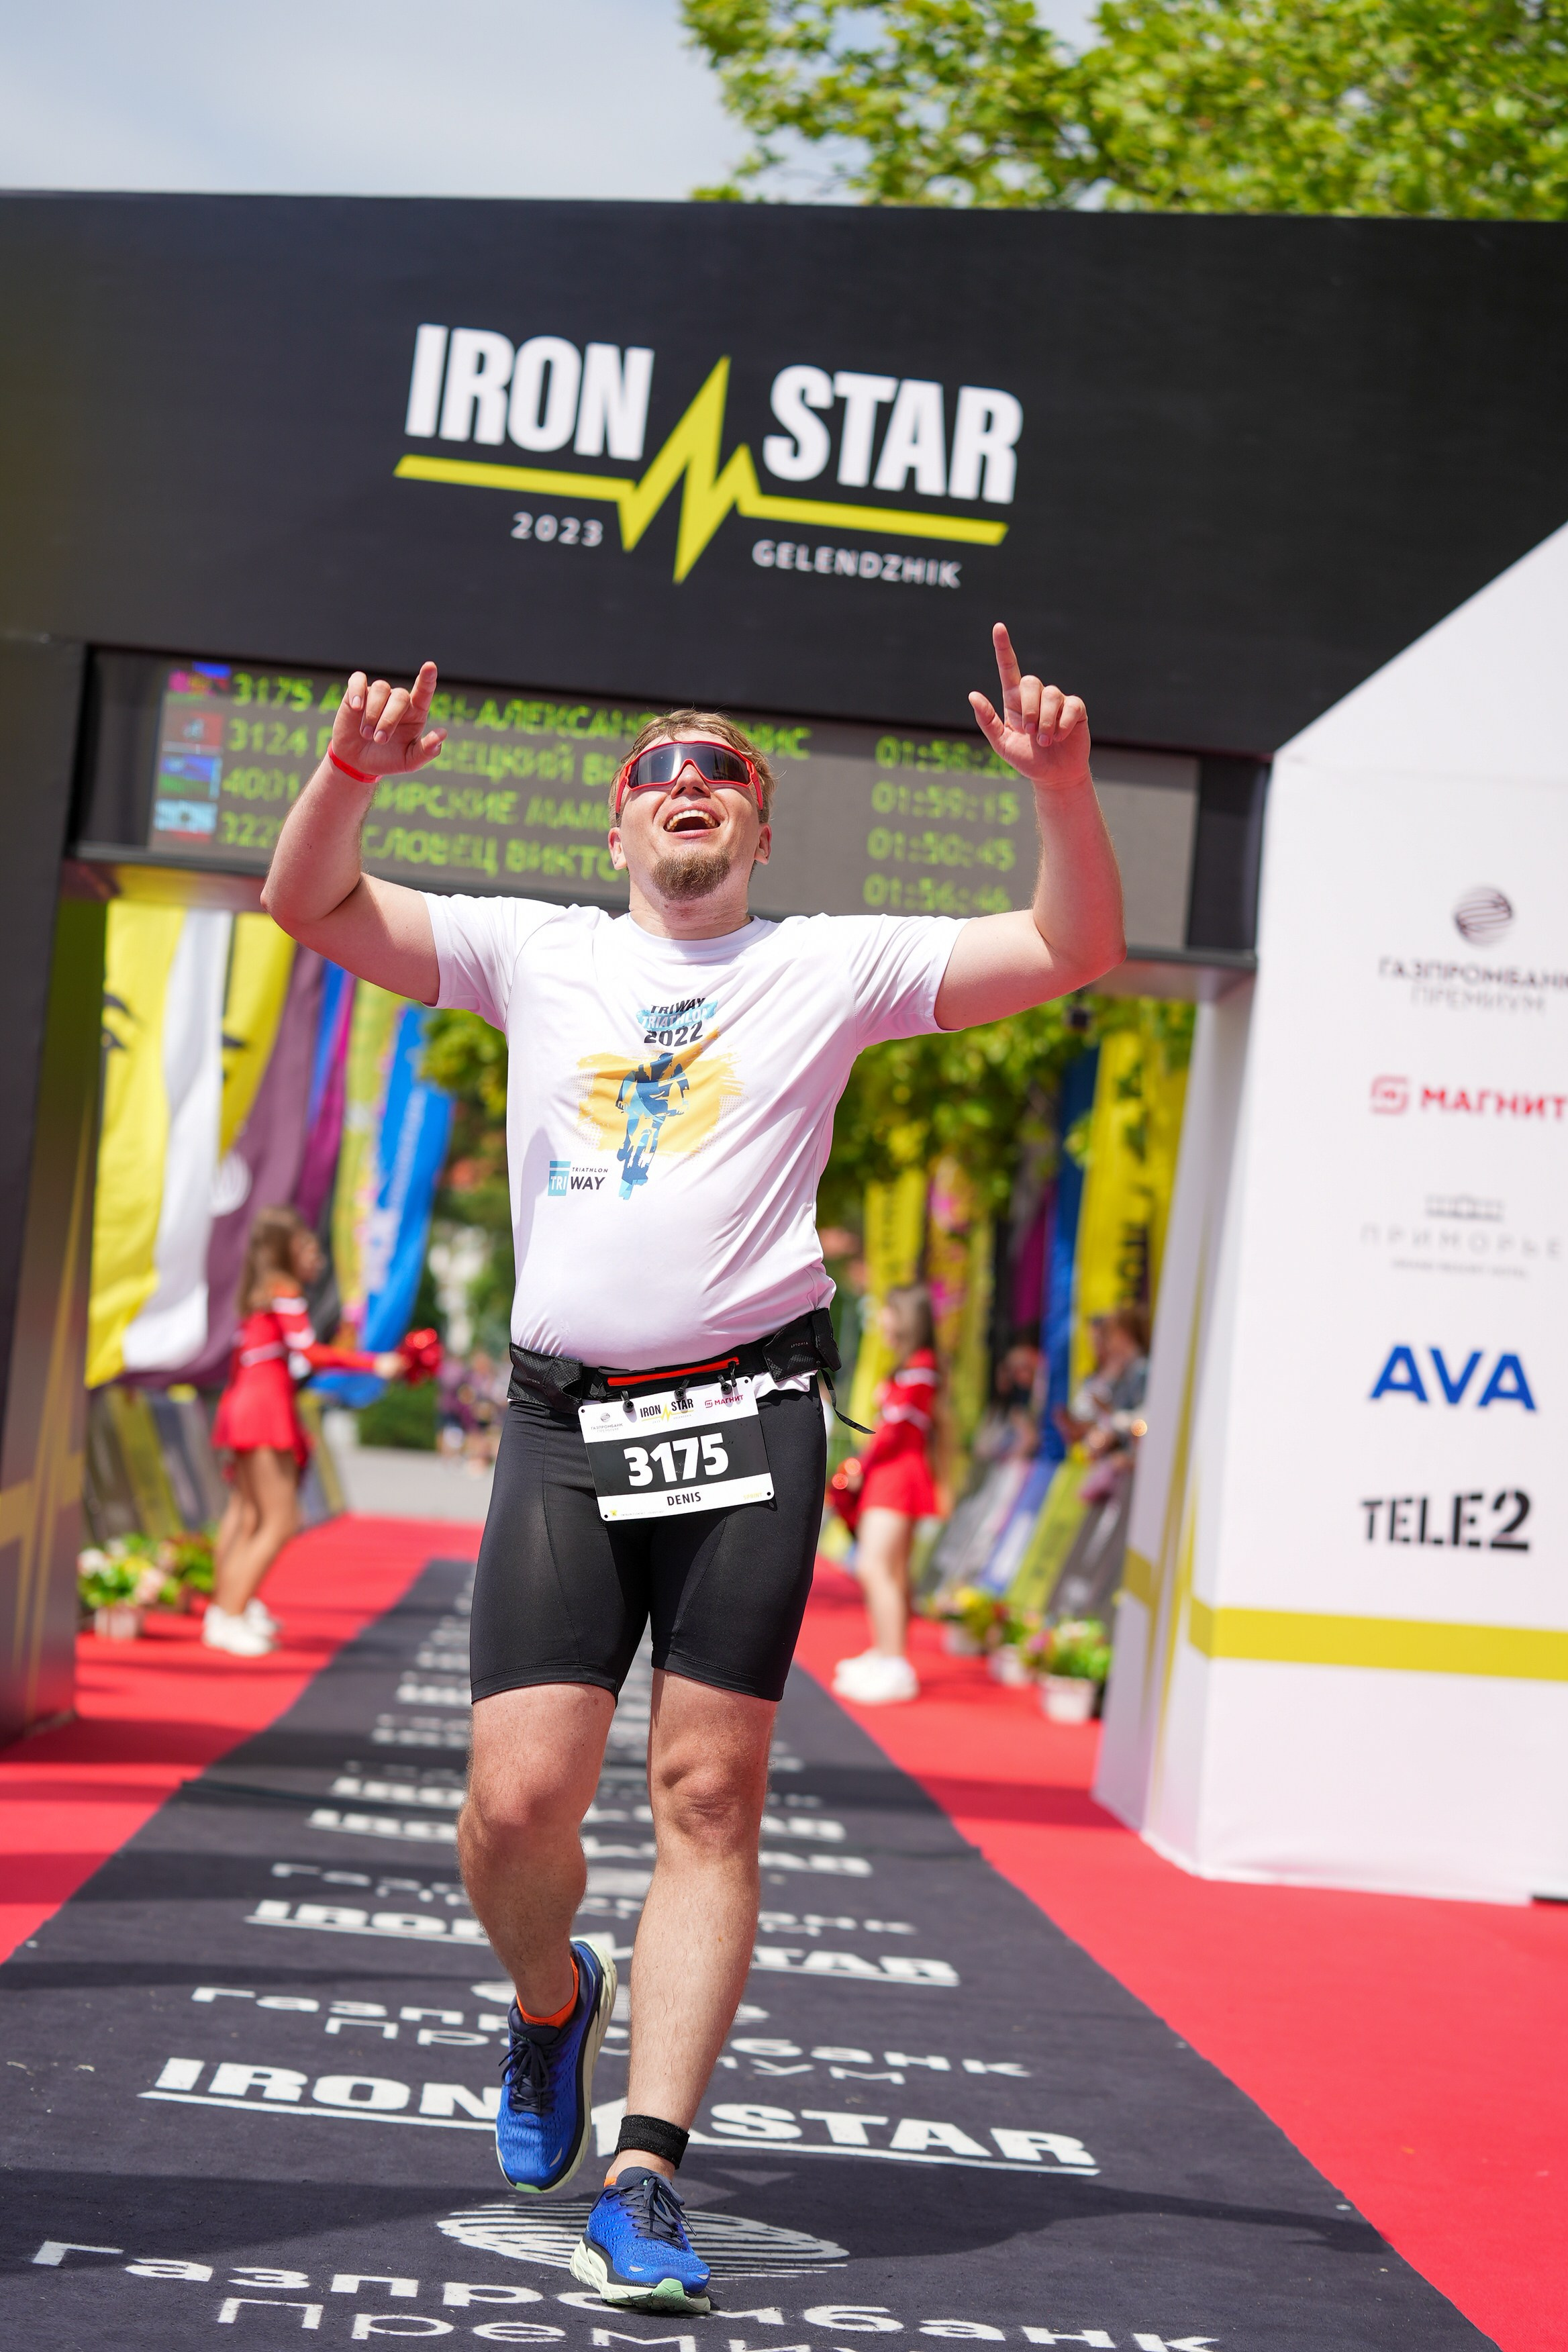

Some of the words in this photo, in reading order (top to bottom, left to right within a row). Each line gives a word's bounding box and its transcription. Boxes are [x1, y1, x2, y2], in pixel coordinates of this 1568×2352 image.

[404, 322, 655, 462] IRON
[762, 363, 1024, 505] STAR
[511, 511, 603, 547] 2023
[752, 539, 962, 589] GELENDZHIK
[233, 672, 313, 713] 3175
[228, 717, 309, 758] 3124
[642, 1007, 710, 1029] TRIATHLON
[650, 997, 705, 1014] TRIWAY
[644, 1020, 703, 1047] 2022
[1420, 1083, 1568, 1120] МАГНИТ
[1369, 1344, 1537, 1412] AVA
[640, 1404, 661, 1418] IRON
[671, 1398, 693, 1412] STAR
[714, 1394, 744, 1406] МАГНИТ
[624, 1432, 729, 1487] 3175
[667, 1491, 702, 1507] DENIS
[1362, 1487, 1530, 1551] TELE2
[710, 2103, 1098, 2165] STAR
